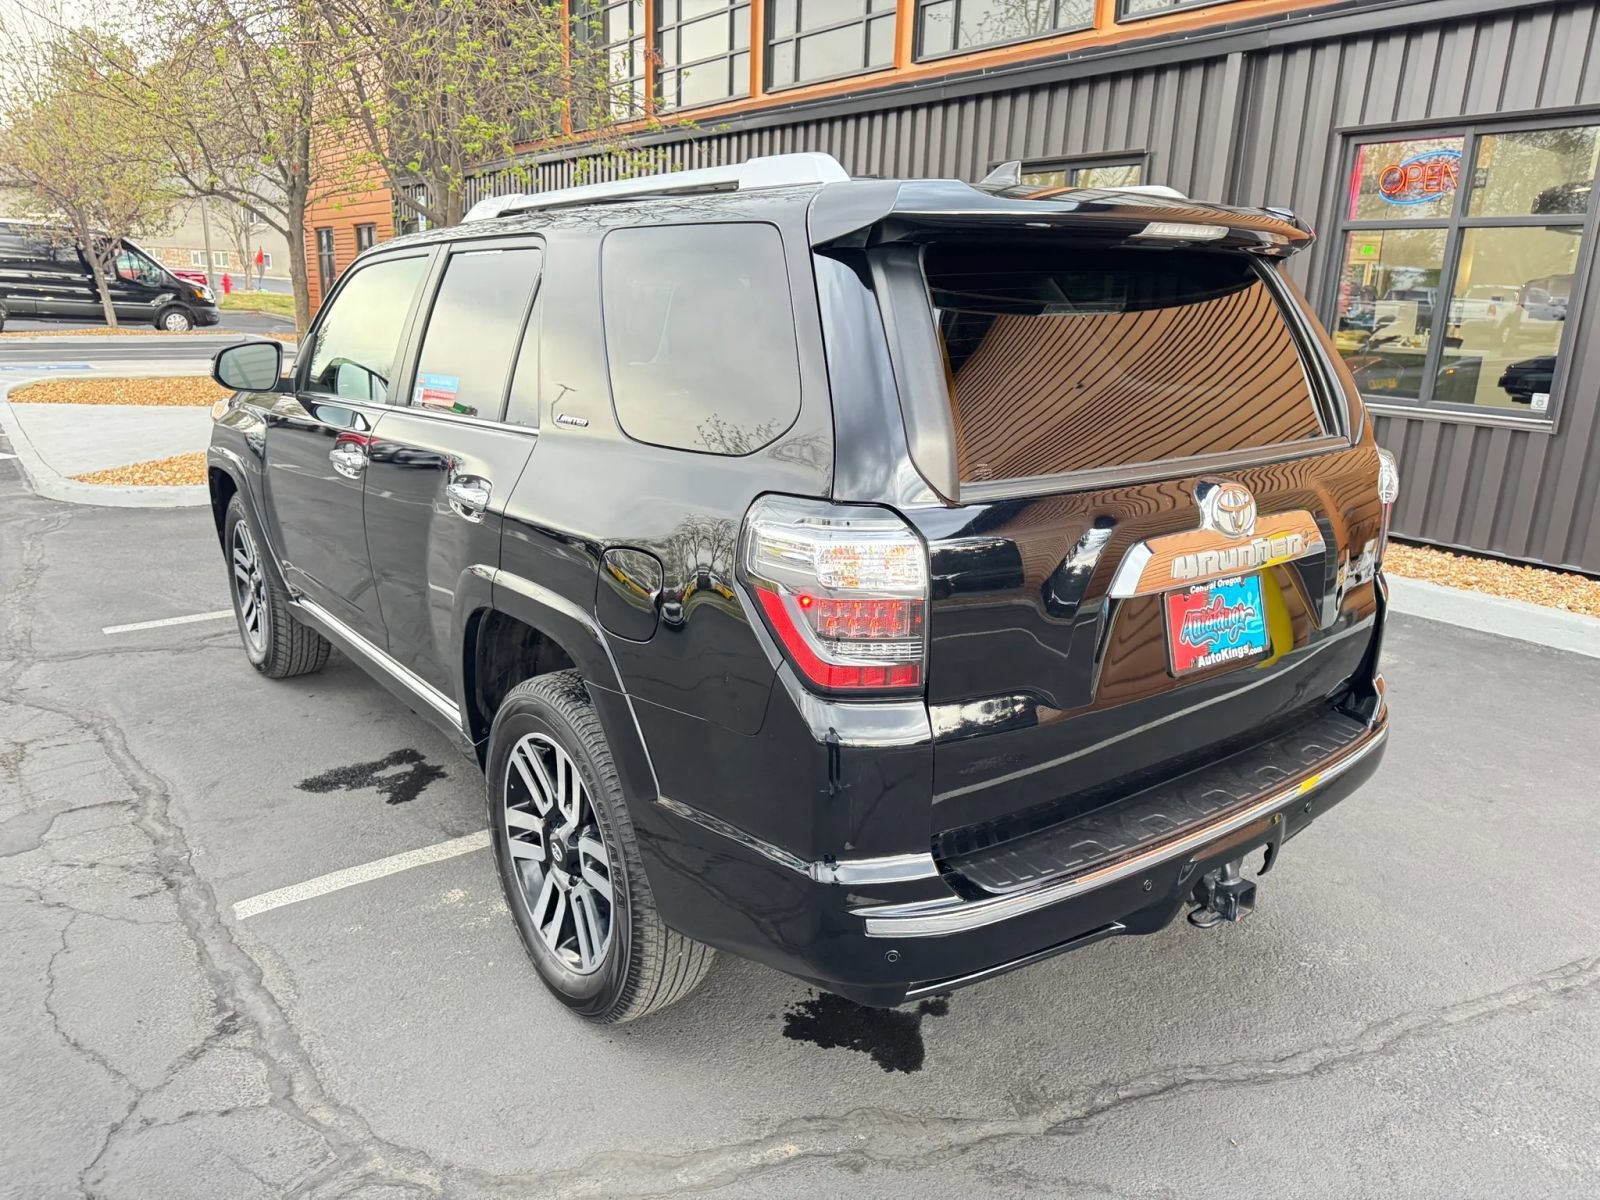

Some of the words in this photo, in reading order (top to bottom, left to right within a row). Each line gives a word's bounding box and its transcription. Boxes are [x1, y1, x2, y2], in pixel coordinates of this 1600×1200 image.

[1378, 162, 1458, 194] OPEN
[1170, 533, 1303, 579] 4RUNNER
[1217, 576, 1242, 590] Oregon
[575, 747, 625, 910] YOKOHAMA
